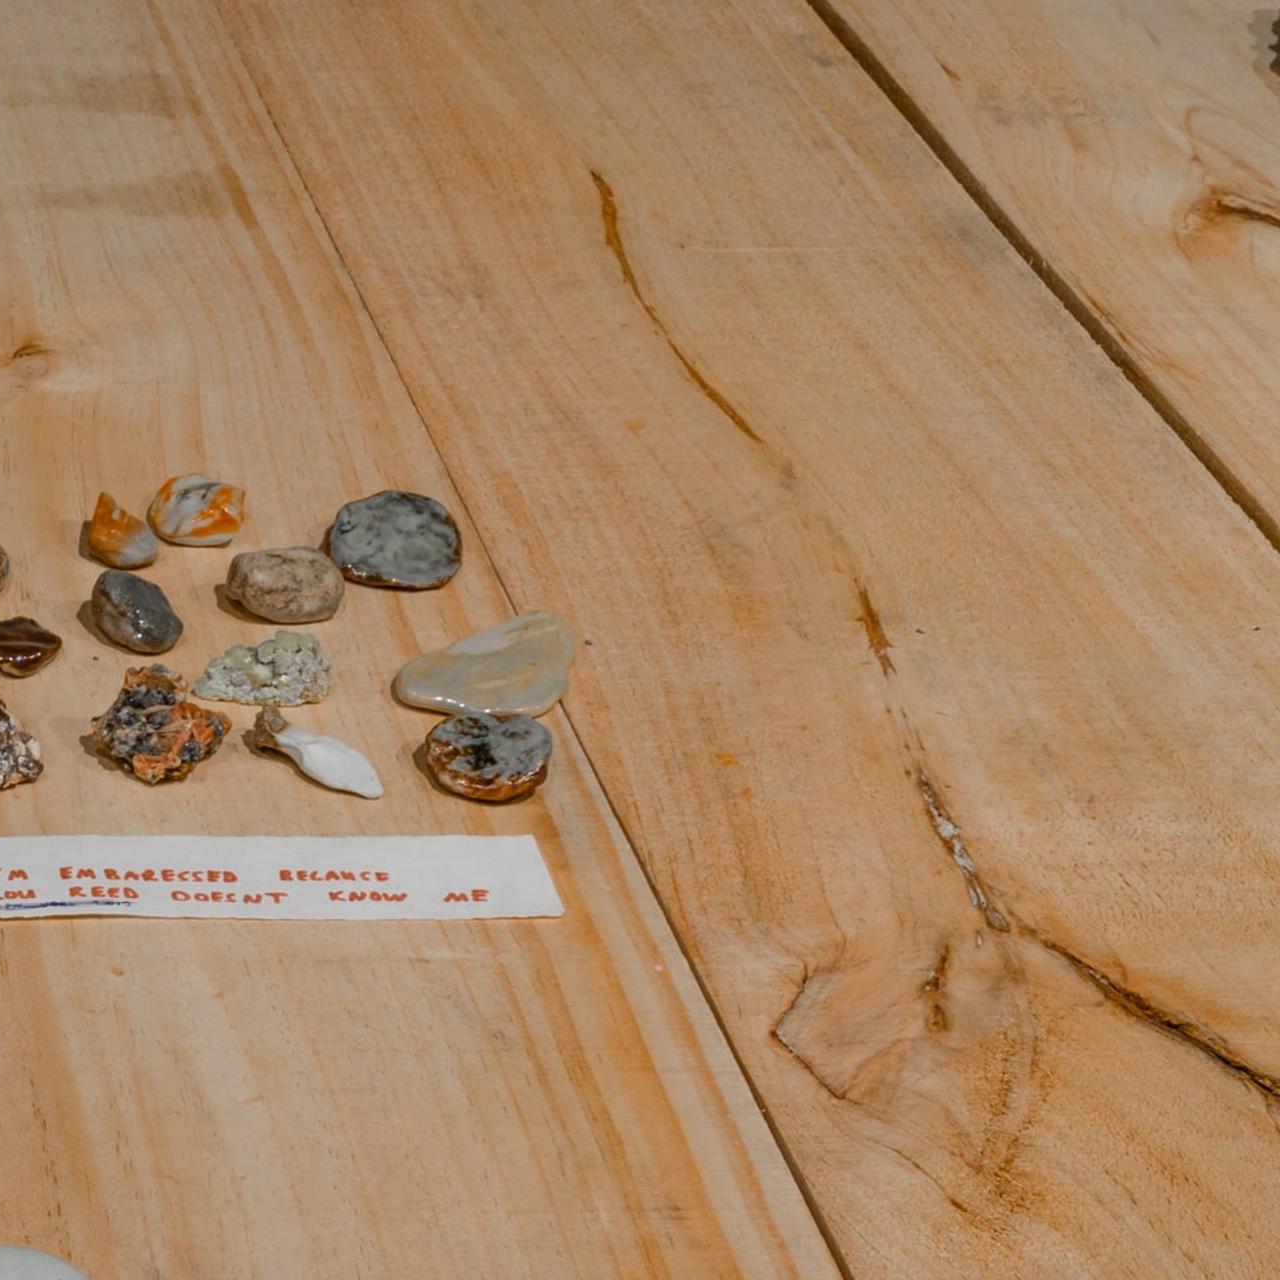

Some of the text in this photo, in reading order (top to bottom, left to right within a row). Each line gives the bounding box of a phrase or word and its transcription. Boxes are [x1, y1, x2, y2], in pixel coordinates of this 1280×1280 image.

[59, 866, 237, 884] EMBARESSED
[279, 869, 389, 882] BECAUSE
[68, 886, 139, 899] REED
[171, 890, 287, 904] DOESNT
[329, 890, 407, 902] KNOW
[444, 888, 489, 902] ME
